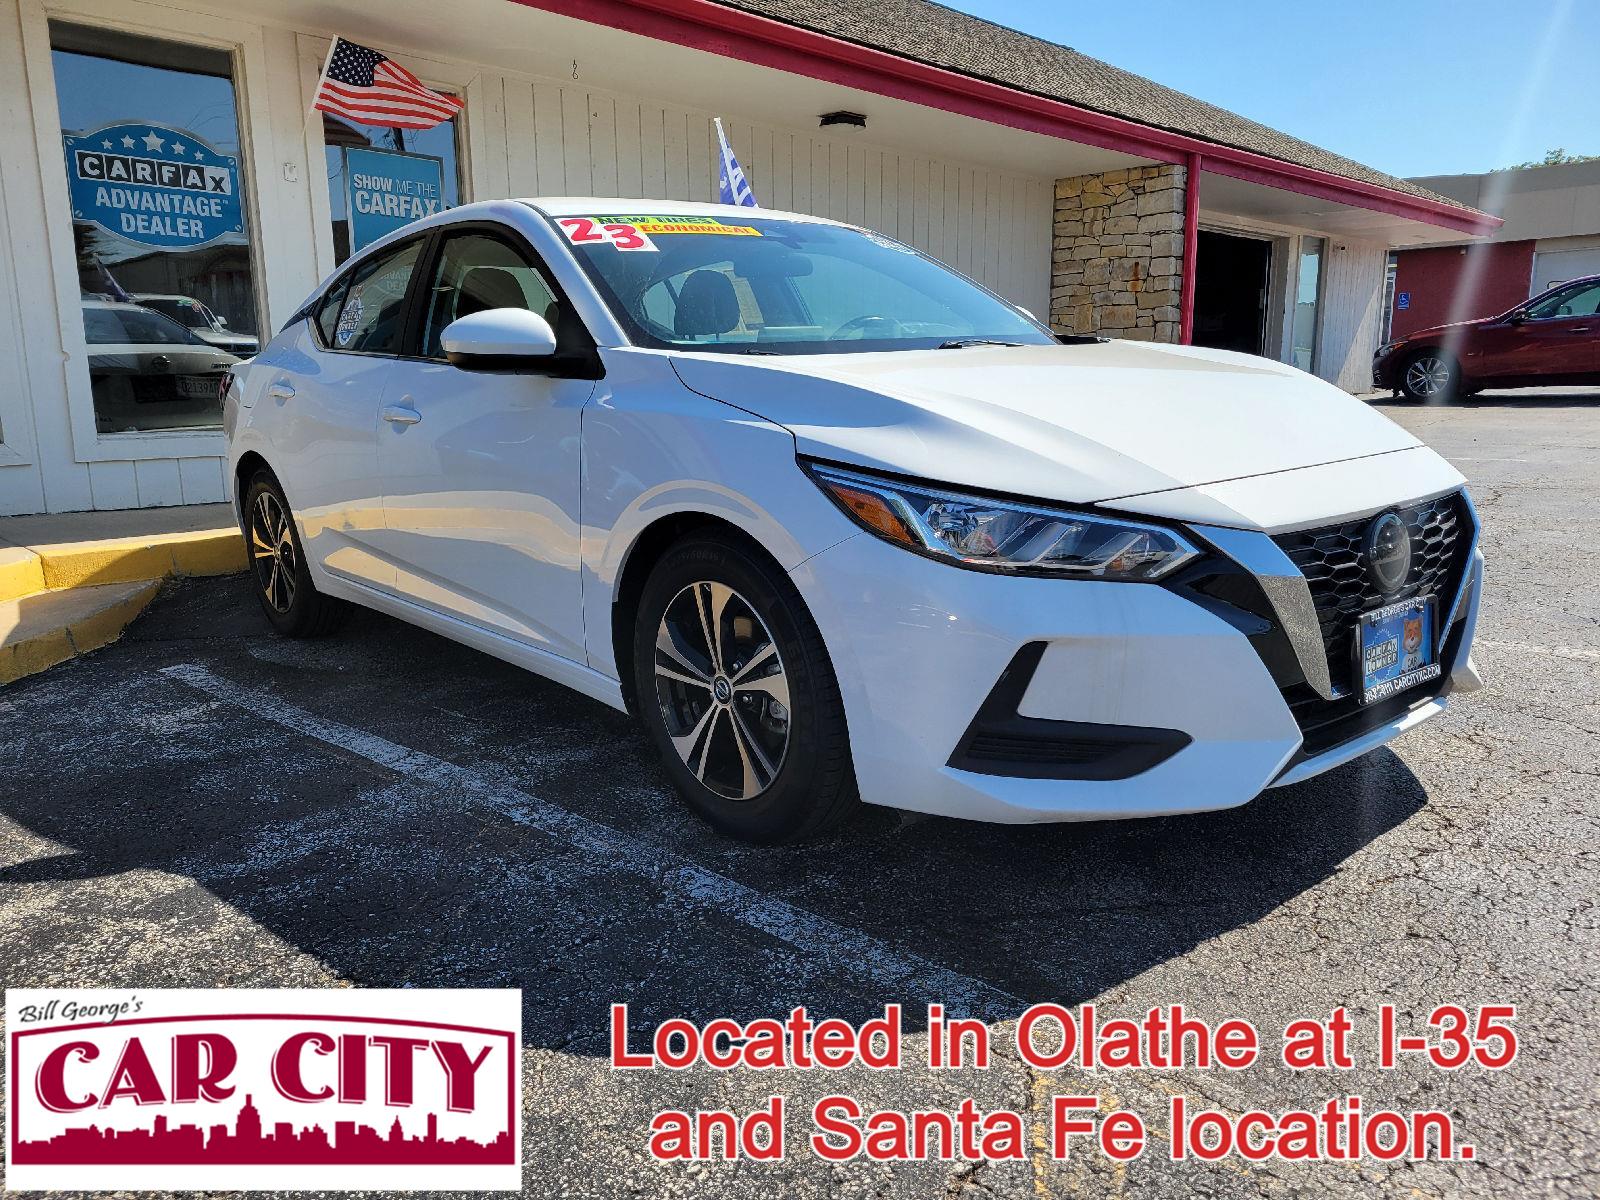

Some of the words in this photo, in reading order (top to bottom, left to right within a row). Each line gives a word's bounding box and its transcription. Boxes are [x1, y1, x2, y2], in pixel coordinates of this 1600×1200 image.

[84, 156, 226, 193] CARFAX
[353, 173, 392, 192] SHOW
[396, 179, 413, 195] ME
[415, 181, 437, 198] THE
[355, 190, 437, 219] CARFAX
[120, 212, 204, 239] DEALER
[599, 216, 649, 225] NEW
[656, 216, 712, 225] TIRES
[641, 224, 752, 235] ECONOMICAL
